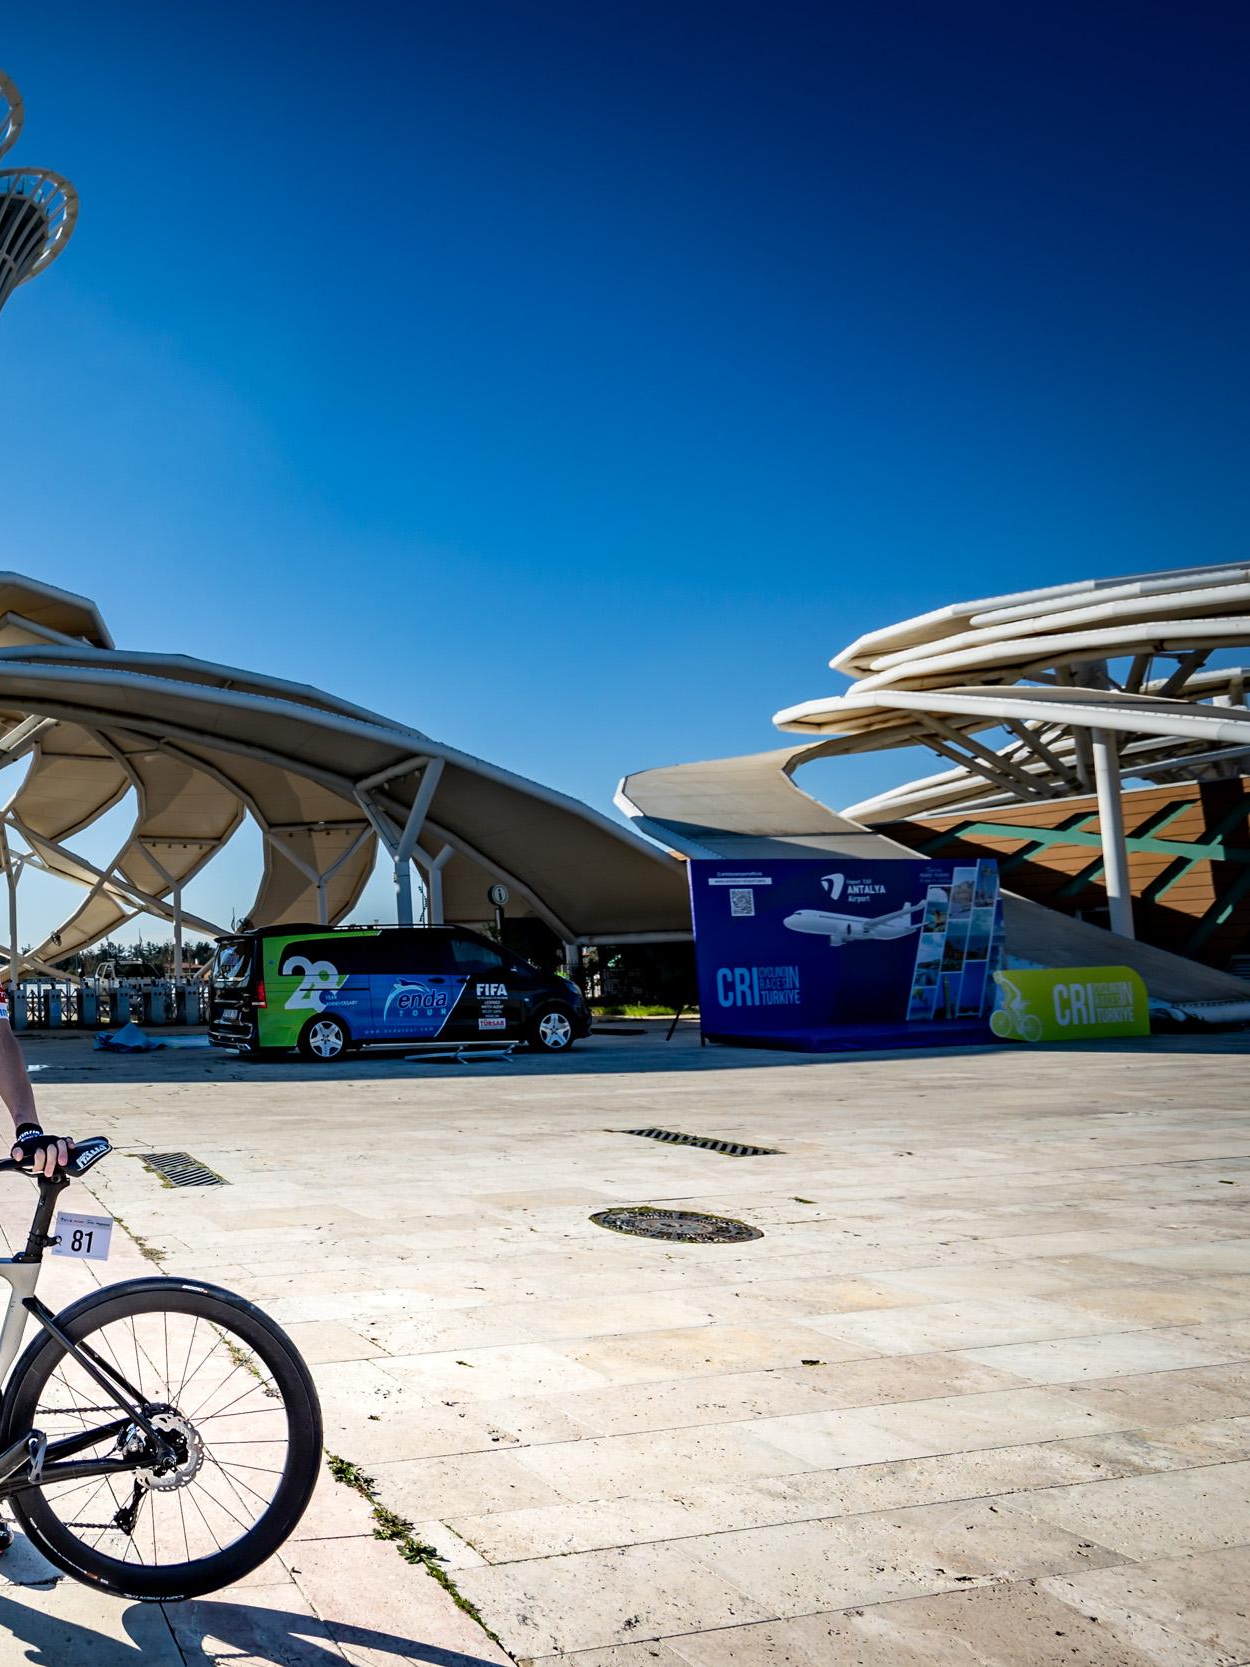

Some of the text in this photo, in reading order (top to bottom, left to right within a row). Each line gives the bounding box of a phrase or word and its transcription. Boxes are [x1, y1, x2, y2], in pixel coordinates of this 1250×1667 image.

[847, 885, 886, 894] ANTALYA
[476, 984, 508, 996] FIFA
[717, 967, 760, 1008] CRI
[398, 989, 447, 1009] enda
[1053, 983, 1096, 1026] CRI
[399, 1009, 447, 1017] TOUR
[71, 1229, 94, 1254] 81
